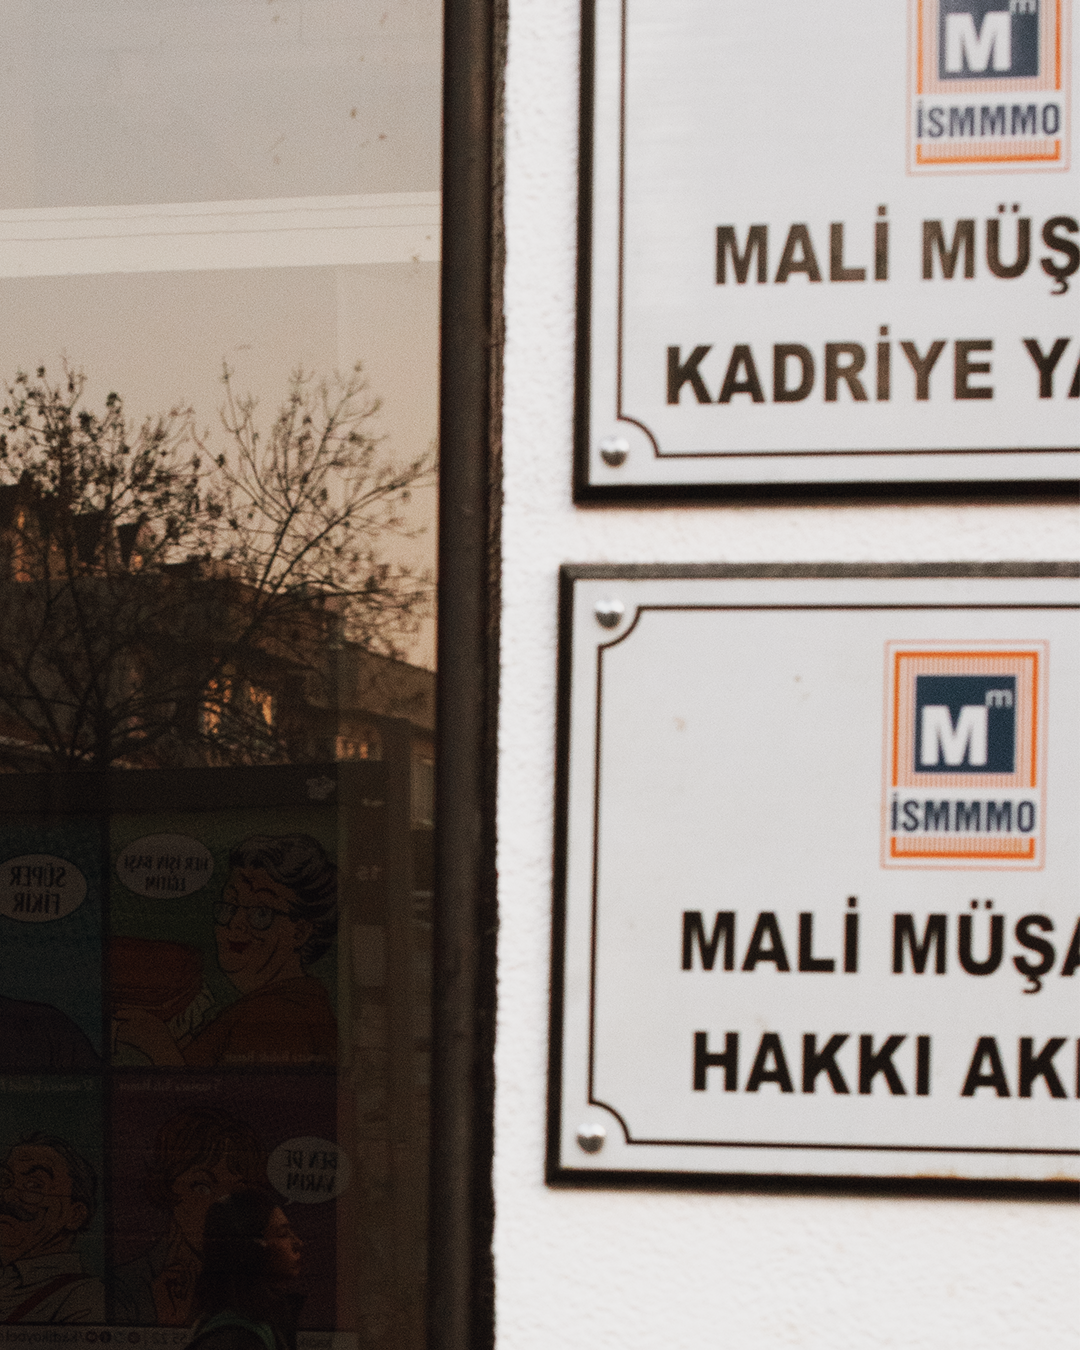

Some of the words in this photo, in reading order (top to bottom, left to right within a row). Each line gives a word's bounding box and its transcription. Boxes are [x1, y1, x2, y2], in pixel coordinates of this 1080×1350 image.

[715, 204, 890, 286] MALİ
[666, 325, 995, 406] KADRİYE
[1023, 337, 1080, 400] Y
[680, 895, 860, 974] MALİ
[692, 1030, 932, 1097] HAKKI
